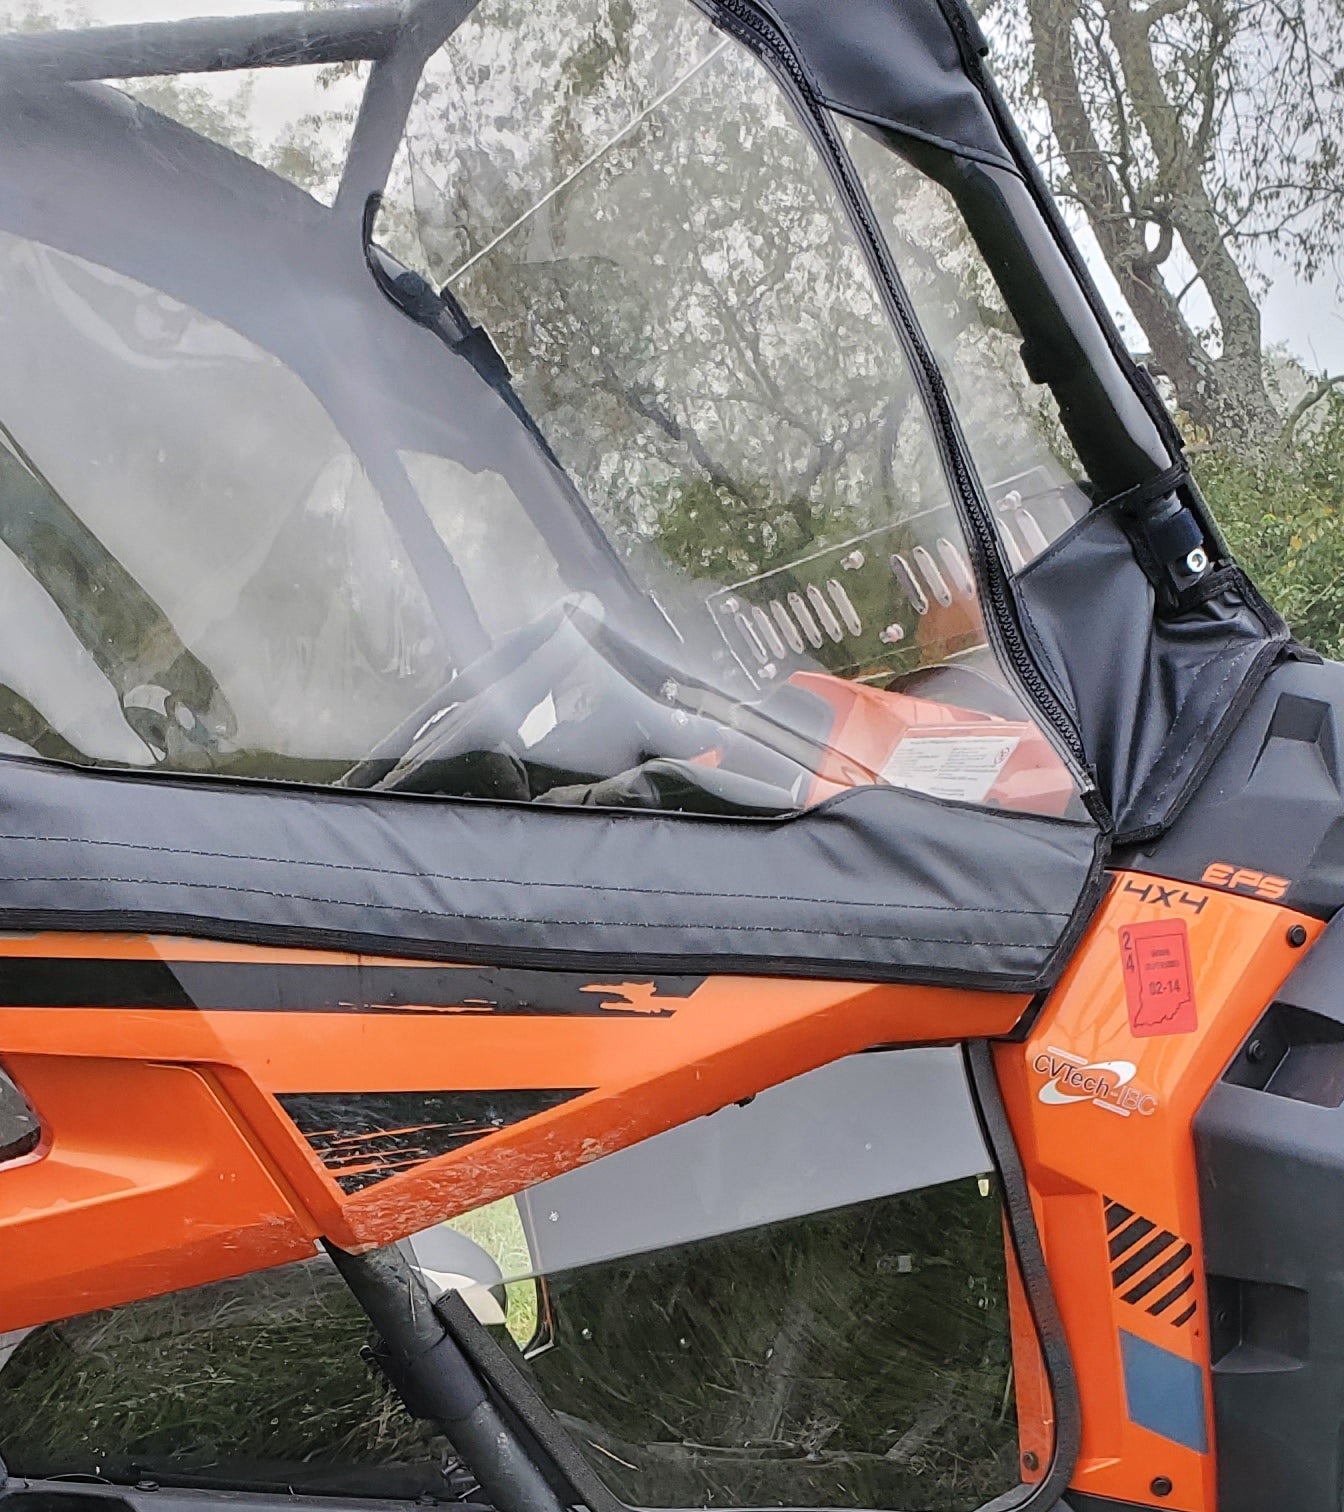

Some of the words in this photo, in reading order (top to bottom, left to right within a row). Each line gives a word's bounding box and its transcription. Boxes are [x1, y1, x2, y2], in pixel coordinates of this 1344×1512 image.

[1123, 879, 1209, 915] 4X4
[1202, 861, 1291, 900] EPS
[1148, 978, 1181, 996] 02-14
